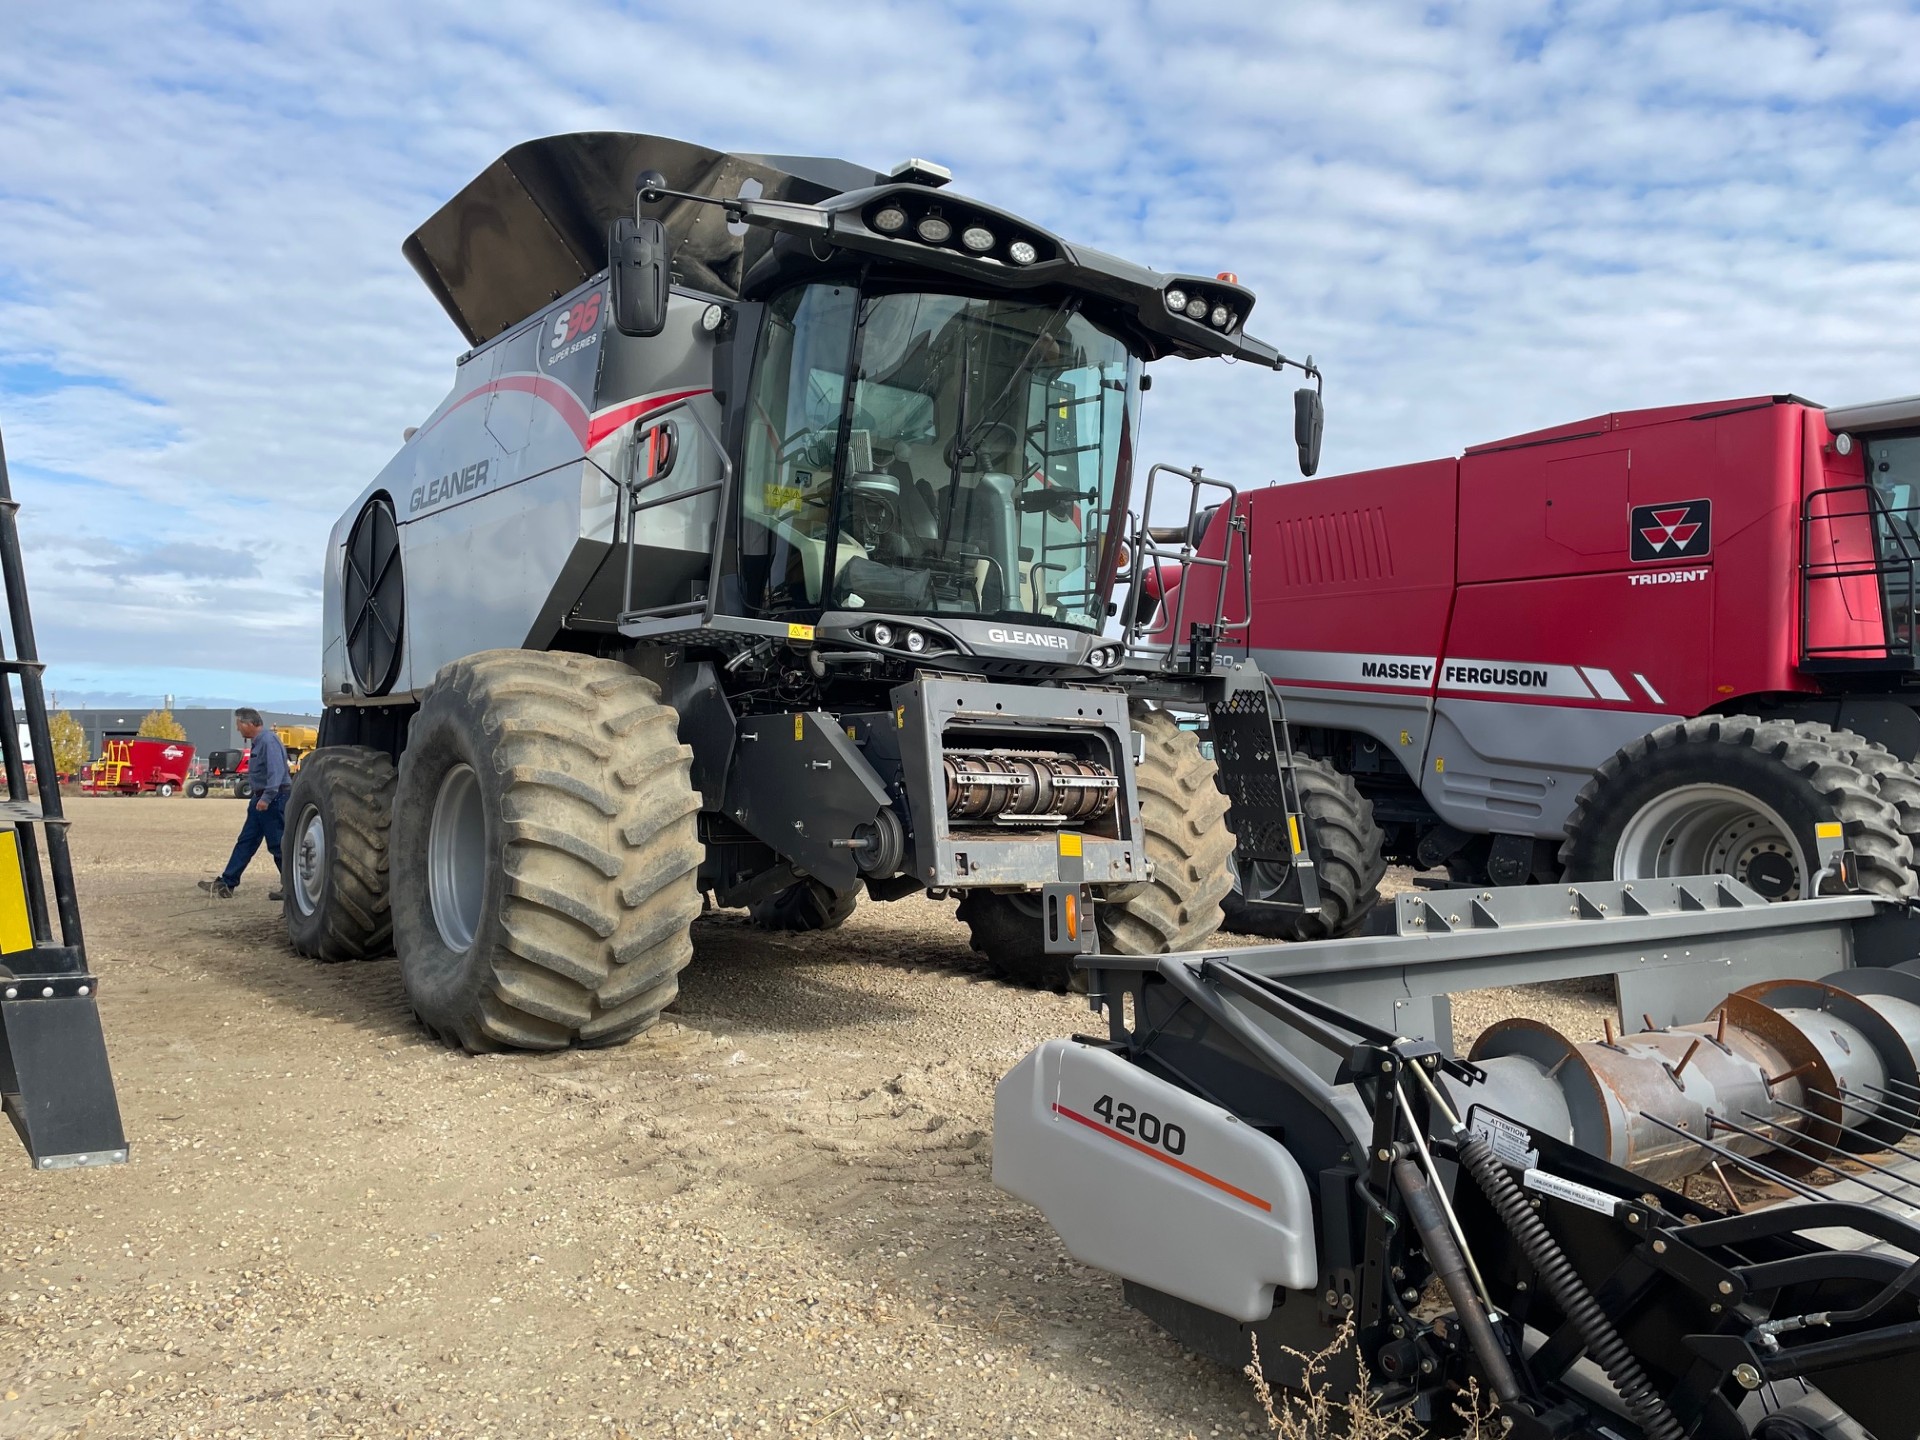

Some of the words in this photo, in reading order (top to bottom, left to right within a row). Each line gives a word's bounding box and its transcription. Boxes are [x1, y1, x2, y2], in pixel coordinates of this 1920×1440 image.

[551, 291, 602, 349] S96
[548, 347, 570, 366] SUPER
[570, 333, 597, 354] SERIES
[409, 459, 489, 513] GLEANER
[1628, 569, 1708, 586] TRIDENT
[988, 628, 1069, 650] GLEANER
[1361, 662, 1433, 681] MASSEY
[1445, 666, 1548, 687] FERGUSON
[1093, 1094, 1186, 1156] 4200
[1490, 1118, 1525, 1138] ATTENTION
[1553, 1184, 1572, 1196] BEFORE
[1572, 1191, 1587, 1200] FIELD
